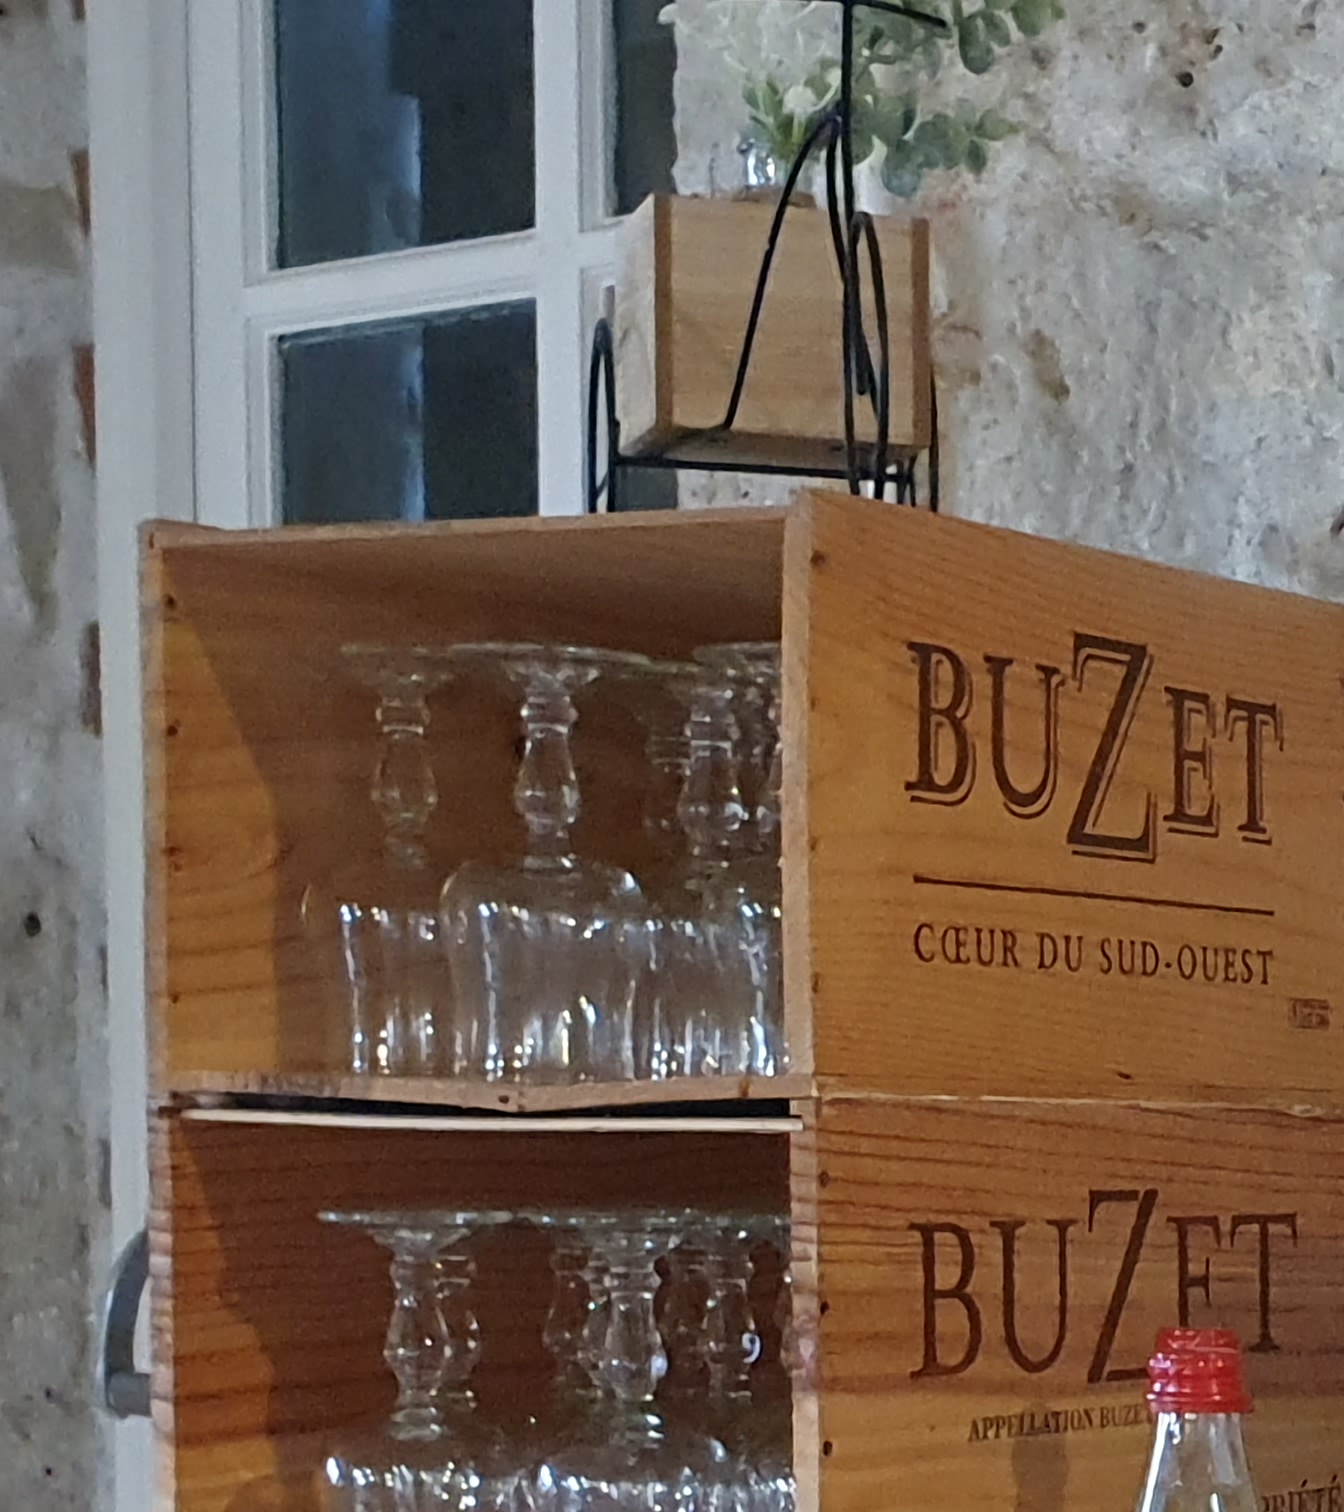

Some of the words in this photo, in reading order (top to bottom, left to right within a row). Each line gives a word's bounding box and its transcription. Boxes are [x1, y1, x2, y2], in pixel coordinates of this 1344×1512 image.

[904, 631, 1285, 864] BUZET
[913, 922, 1020, 968] CŒUR
[1036, 932, 1085, 973] DU
[907, 1188, 1298, 1384] BUZET
[968, 1406, 1095, 1443] APPELLATION
